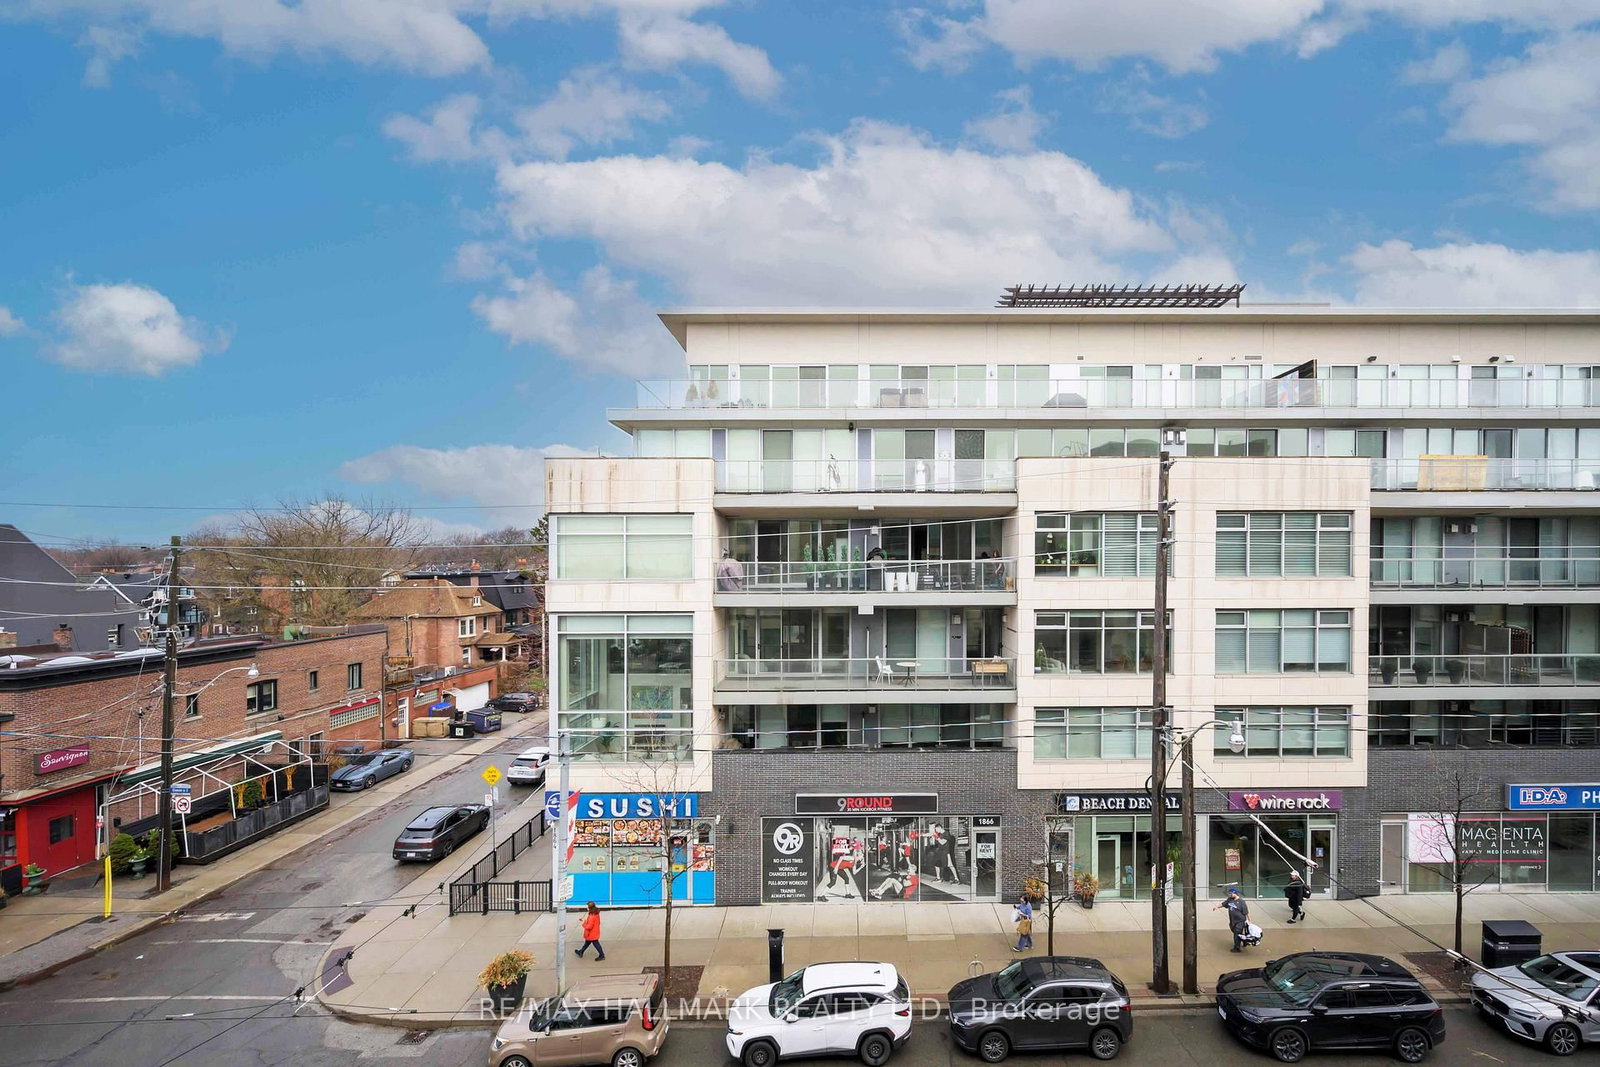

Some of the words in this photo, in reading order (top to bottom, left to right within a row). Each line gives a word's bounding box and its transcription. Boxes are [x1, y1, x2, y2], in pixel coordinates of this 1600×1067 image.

[40, 751, 89, 768] Sauvignon
[587, 798, 692, 818] SUSHI
[1081, 798, 1126, 810] BEACH
[1128, 797, 1180, 809] DENAL
[1260, 794, 1296, 809] wine
[1296, 793, 1331, 809] rack
[1461, 827, 1544, 840] MAGENTA
